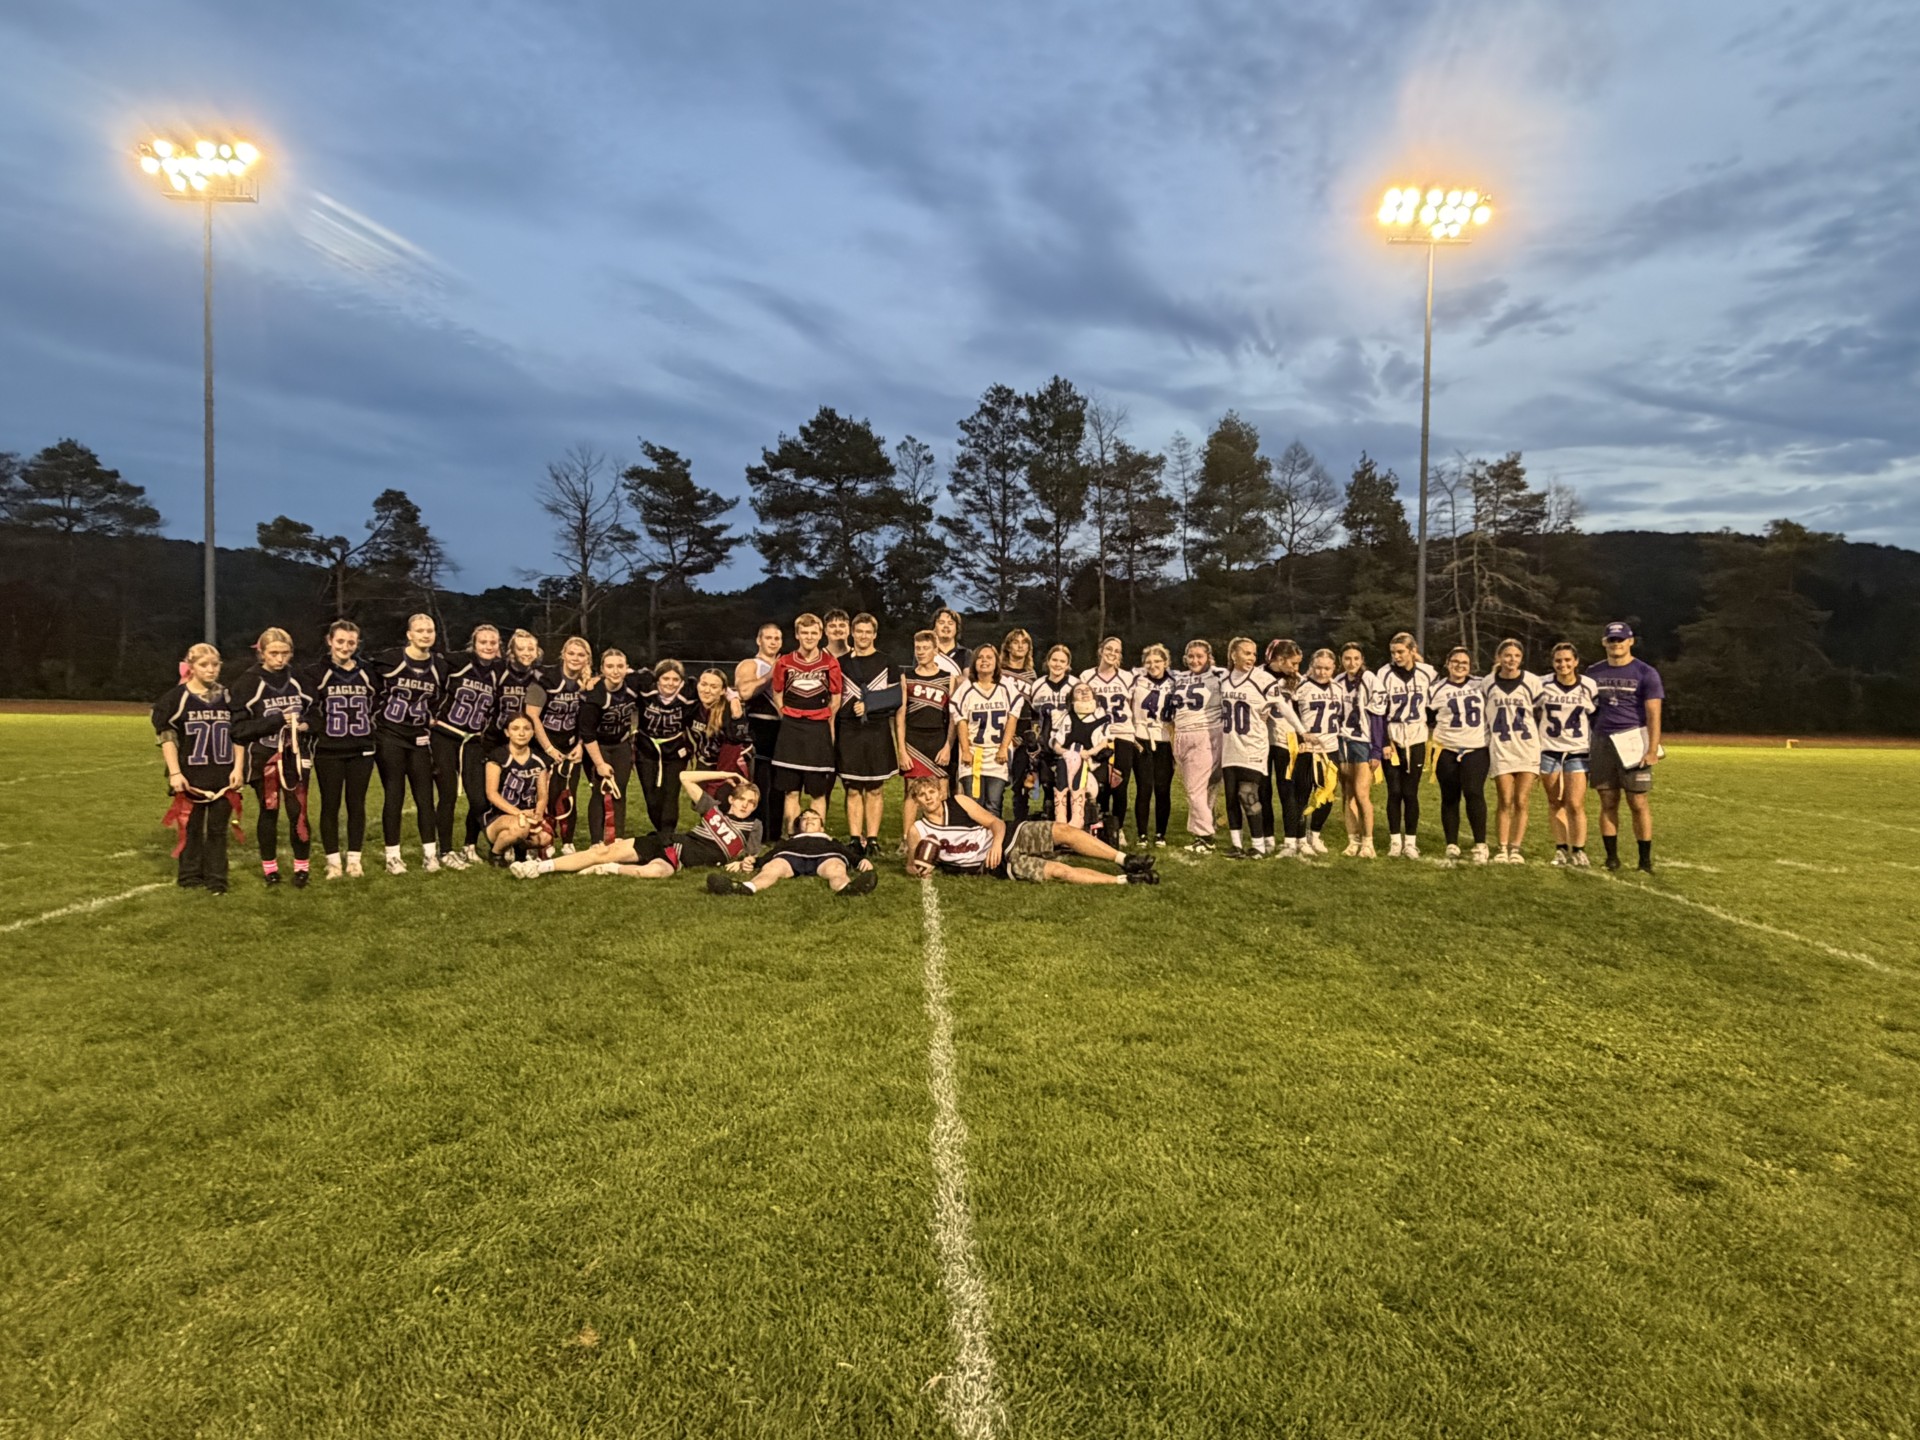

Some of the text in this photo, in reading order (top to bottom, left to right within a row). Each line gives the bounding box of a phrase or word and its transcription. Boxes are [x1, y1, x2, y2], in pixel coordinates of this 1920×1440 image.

[327, 685, 367, 695] EAGLES
[397, 678, 435, 692] EAGLES
[504, 686, 525, 695] EAGL
[914, 685, 945, 703] S-VE
[1093, 686, 1122, 694] EAGLES
[1446, 689, 1479, 699] EAGLES
[263, 696, 302, 708] EAGLES
[384, 686, 432, 726] 64
[448, 687, 493, 730] 66
[974, 701, 1004, 710] EAGLES
[1494, 698, 1523, 707] EAGLES
[1548, 695, 1582, 705] EAGLES
[188, 710, 231, 720] EAGLES
[326, 696, 371, 737] 63
[1309, 701, 1341, 734] 72
[1447, 696, 1481, 728] 16
[1545, 703, 1584, 738] 54
[972, 710, 1006, 744] 75
[1493, 707, 1532, 742] 44
[184, 721, 234, 765] 70
[709, 815, 737, 845] S-VE
